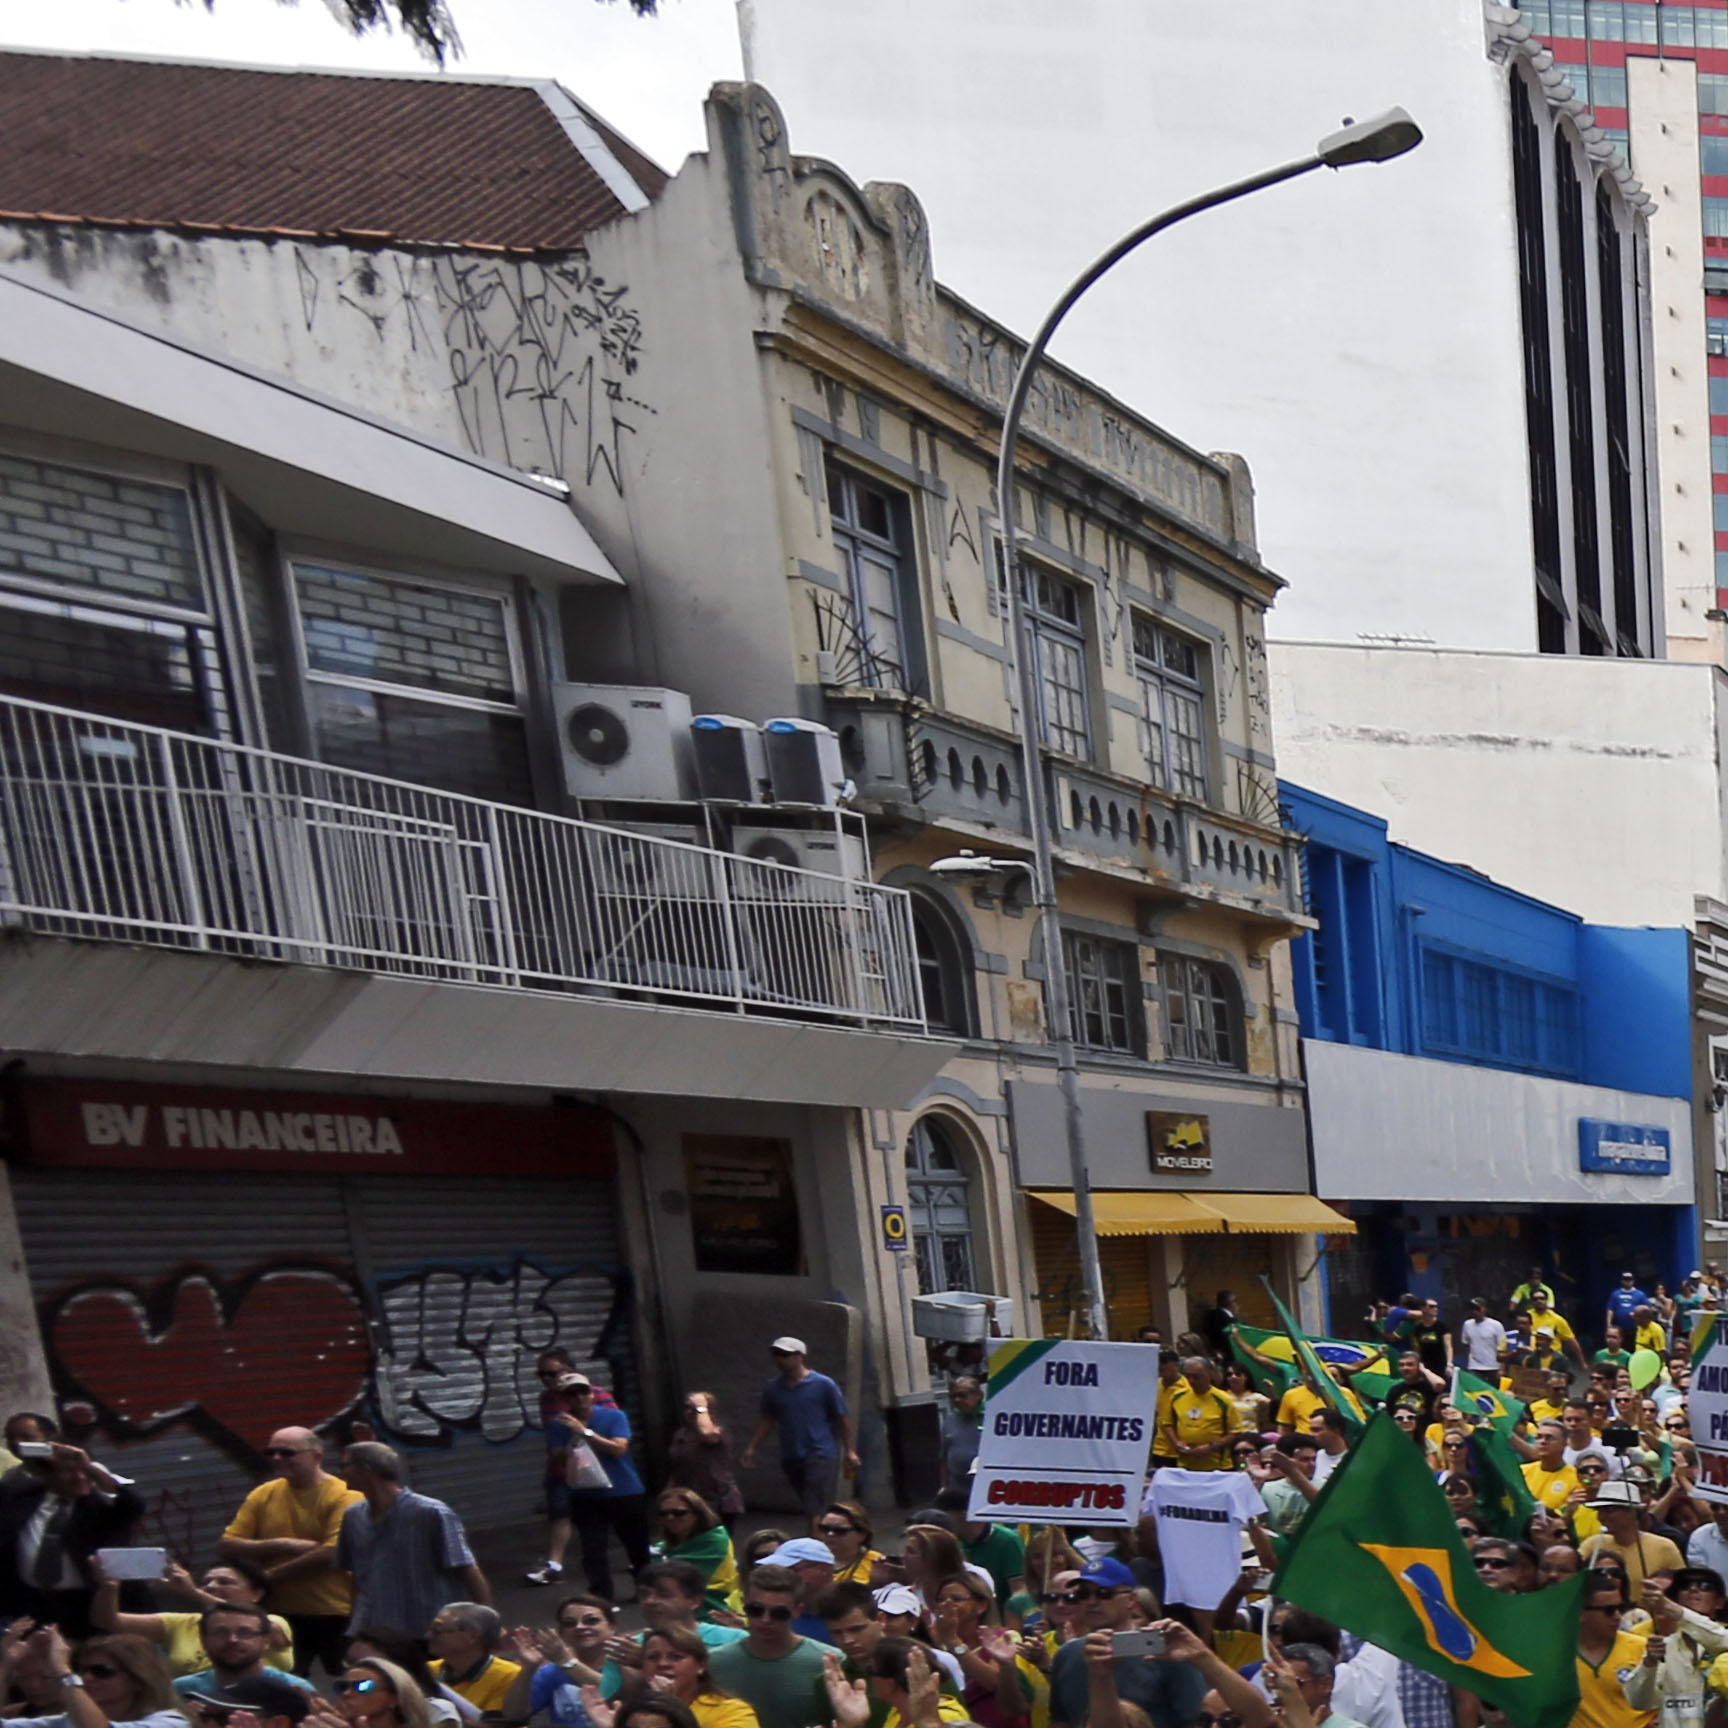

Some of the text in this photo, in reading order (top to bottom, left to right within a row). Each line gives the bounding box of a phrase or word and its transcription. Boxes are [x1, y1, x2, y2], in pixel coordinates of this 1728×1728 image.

[81, 1102, 404, 1155] BV FINANCEIRA
[1045, 1361, 1099, 1387] FORA
[994, 1412, 1143, 1442] GOVERNANTES
[987, 1480, 1126, 1510] CORRUPTOS
